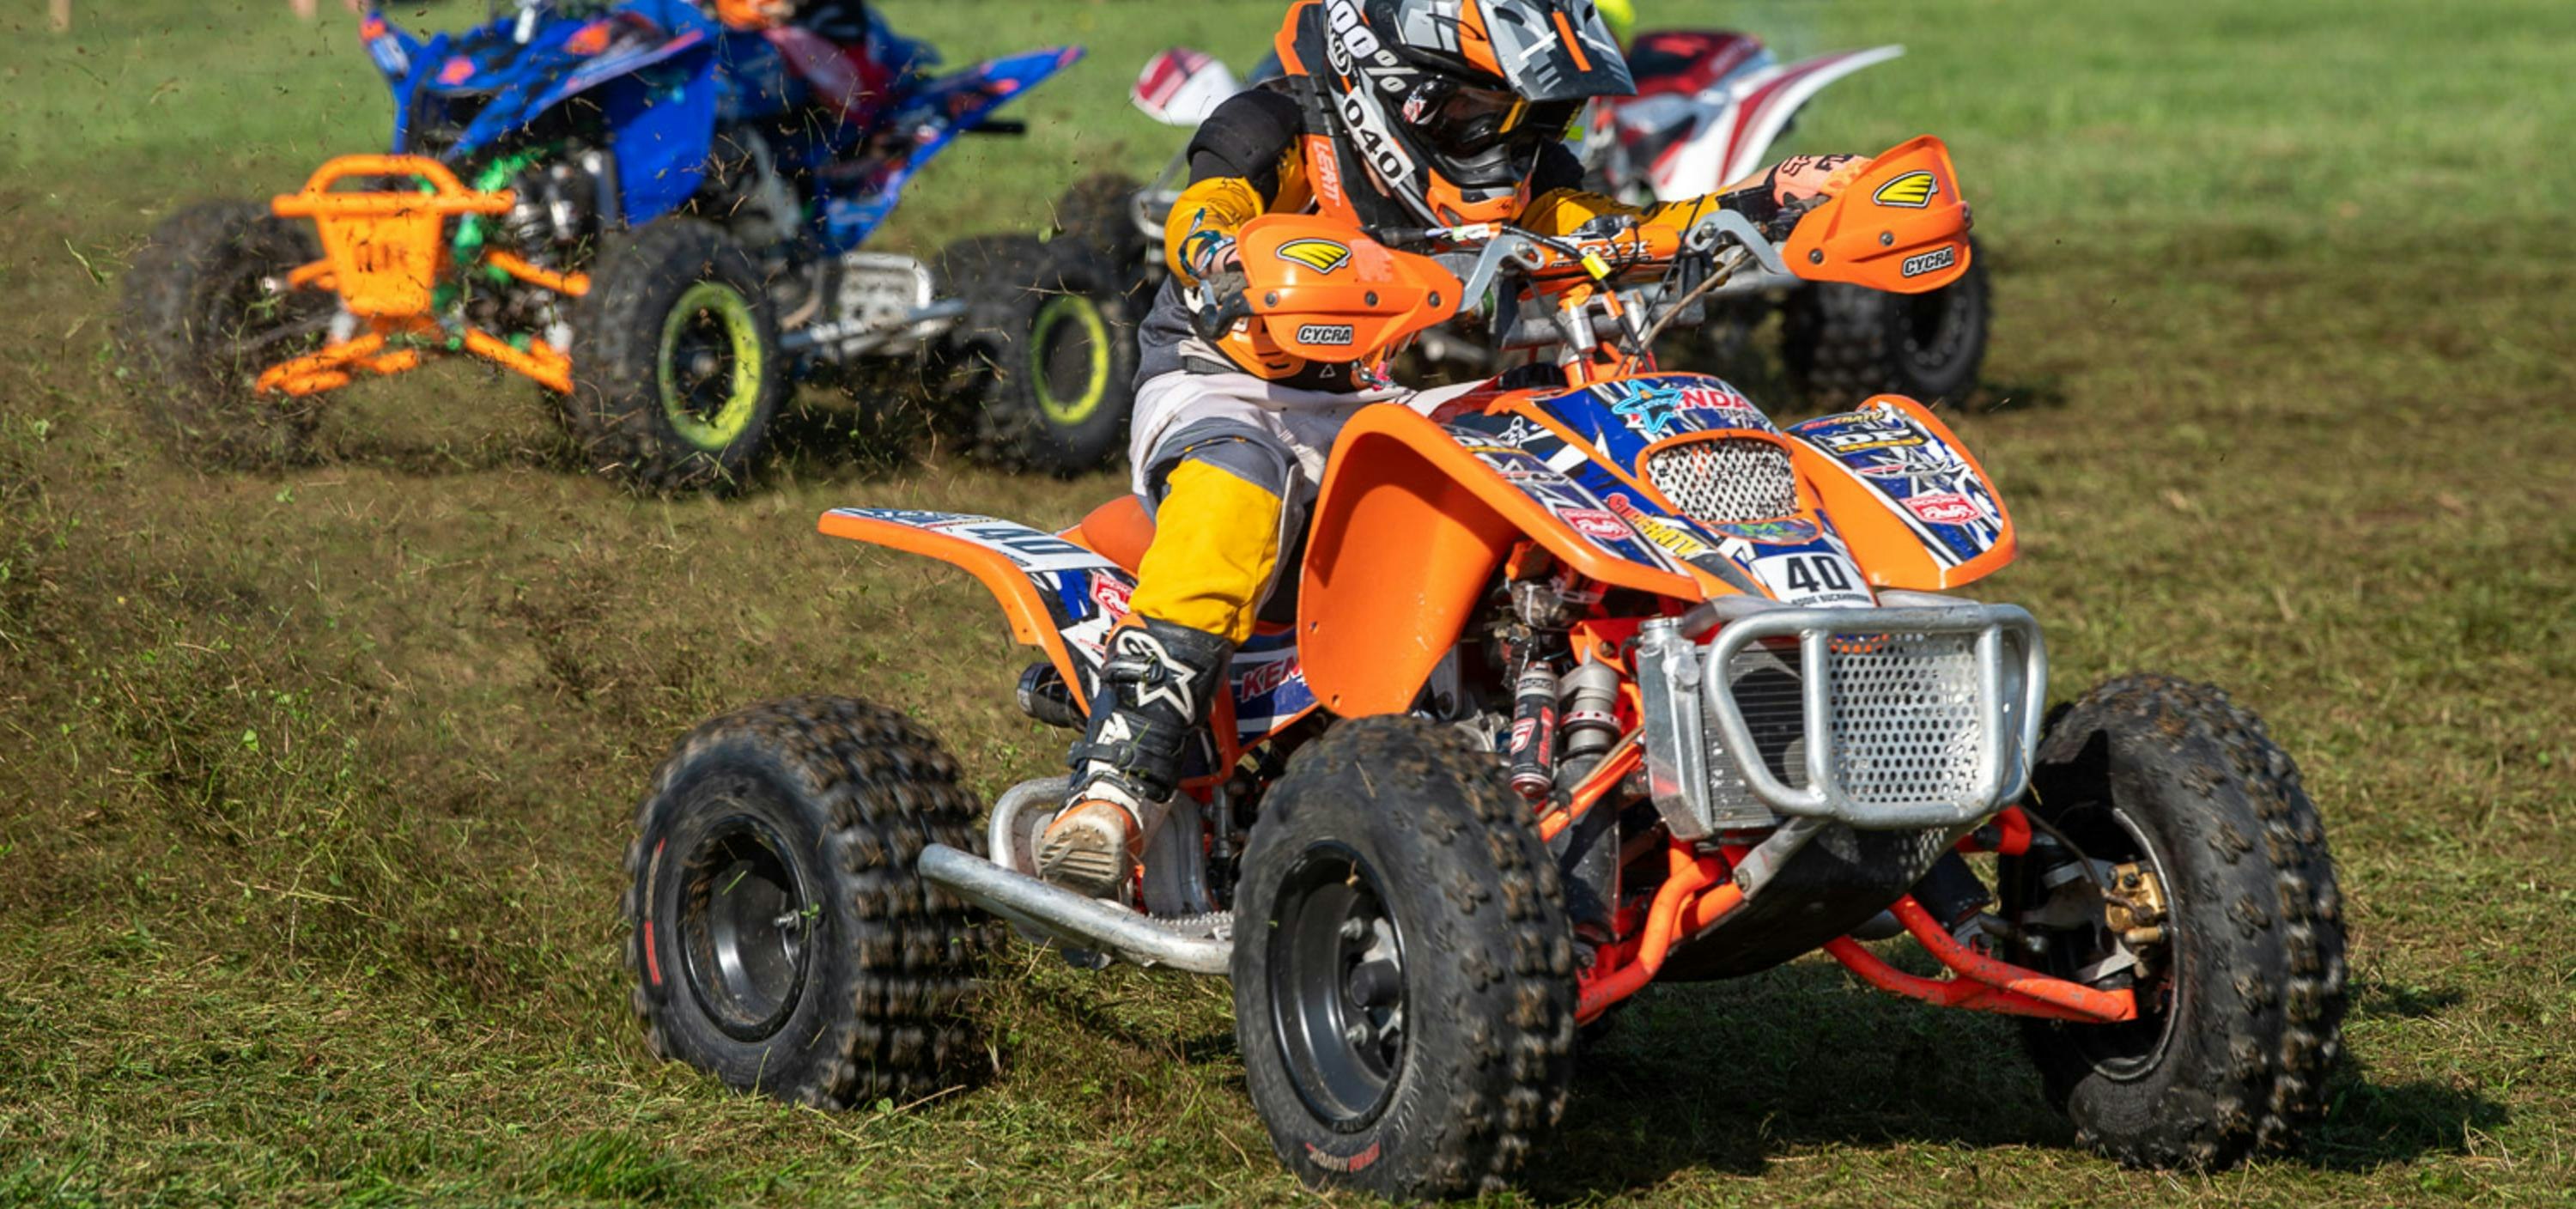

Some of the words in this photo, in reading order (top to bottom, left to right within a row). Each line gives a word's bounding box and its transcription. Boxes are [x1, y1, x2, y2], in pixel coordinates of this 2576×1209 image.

[1327, 0, 1419, 93] 00%
[1345, 98, 1403, 179] 040
[1904, 249, 1955, 275] CYCRA
[1299, 326, 1352, 343] CYCRA
[1786, 556, 1853, 592] 40
[1242, 655, 1300, 702] KEN
